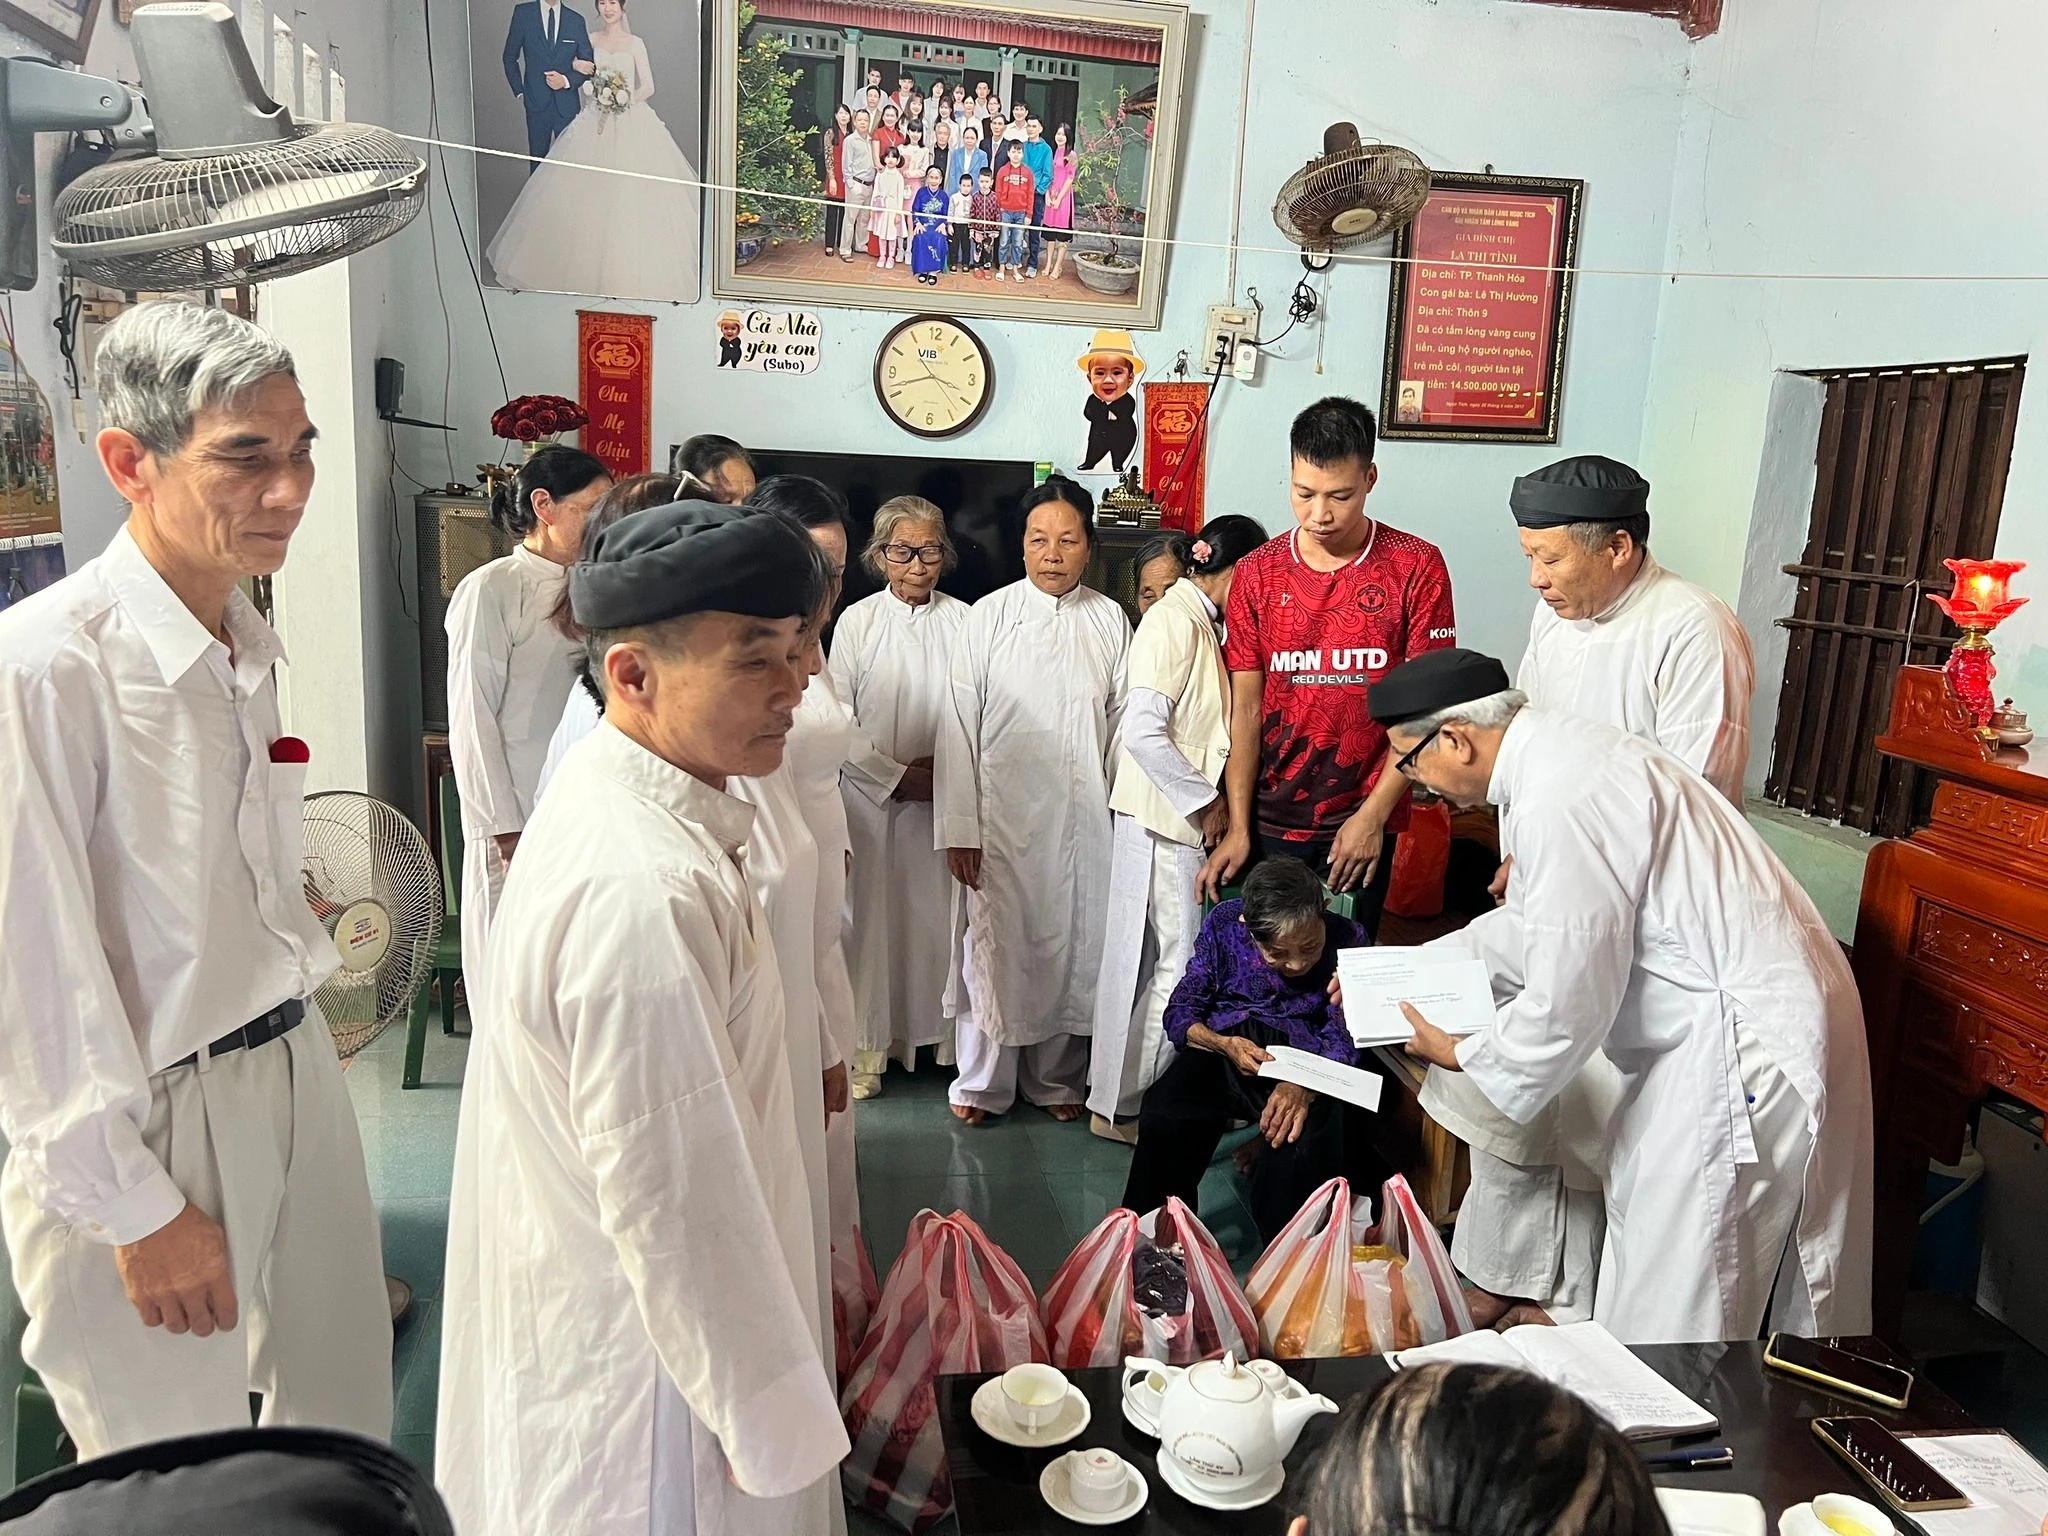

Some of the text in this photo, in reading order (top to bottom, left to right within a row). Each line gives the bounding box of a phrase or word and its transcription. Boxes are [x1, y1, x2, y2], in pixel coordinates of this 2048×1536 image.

[1422, 269, 1437, 280] Địa
[1460, 271, 1473, 280] TP.
[1476, 272, 1505, 282] Thanh
[1507, 273, 1525, 283] Hóa
[1420, 288, 1439, 297] Con
[1490, 291, 1504, 303] Thị
[1418, 306, 1434, 318] Địa
[1456, 308, 1480, 318] Thôn
[1482, 309, 1488, 318] 9
[747, 311, 819, 336] Cả Nhà
[929, 327, 943, 341] 12
[1417, 325, 1430, 334] Đã
[1432, 326, 1444, 334] có
[1489, 328, 1511, 340] vàng
[1513, 331, 1537, 341] cung
[596, 342, 635, 368] 福
[785, 344, 817, 356] con
[918, 348, 937, 359] VIB
[764, 359, 805, 373] (Subo)
[889, 366, 897, 379] 9
[968, 374, 976, 386] 3
[1451, 381, 1498, 391] 14.500.000
[599, 385, 629, 403] Cha
[600, 413, 625, 434] Mẹ
[926, 413, 934, 425] 6
[1159, 411, 1191, 433] 福
[1270, 648, 1388, 672] MAN UTD
[1292, 674, 1364, 684] RED DEVILS
